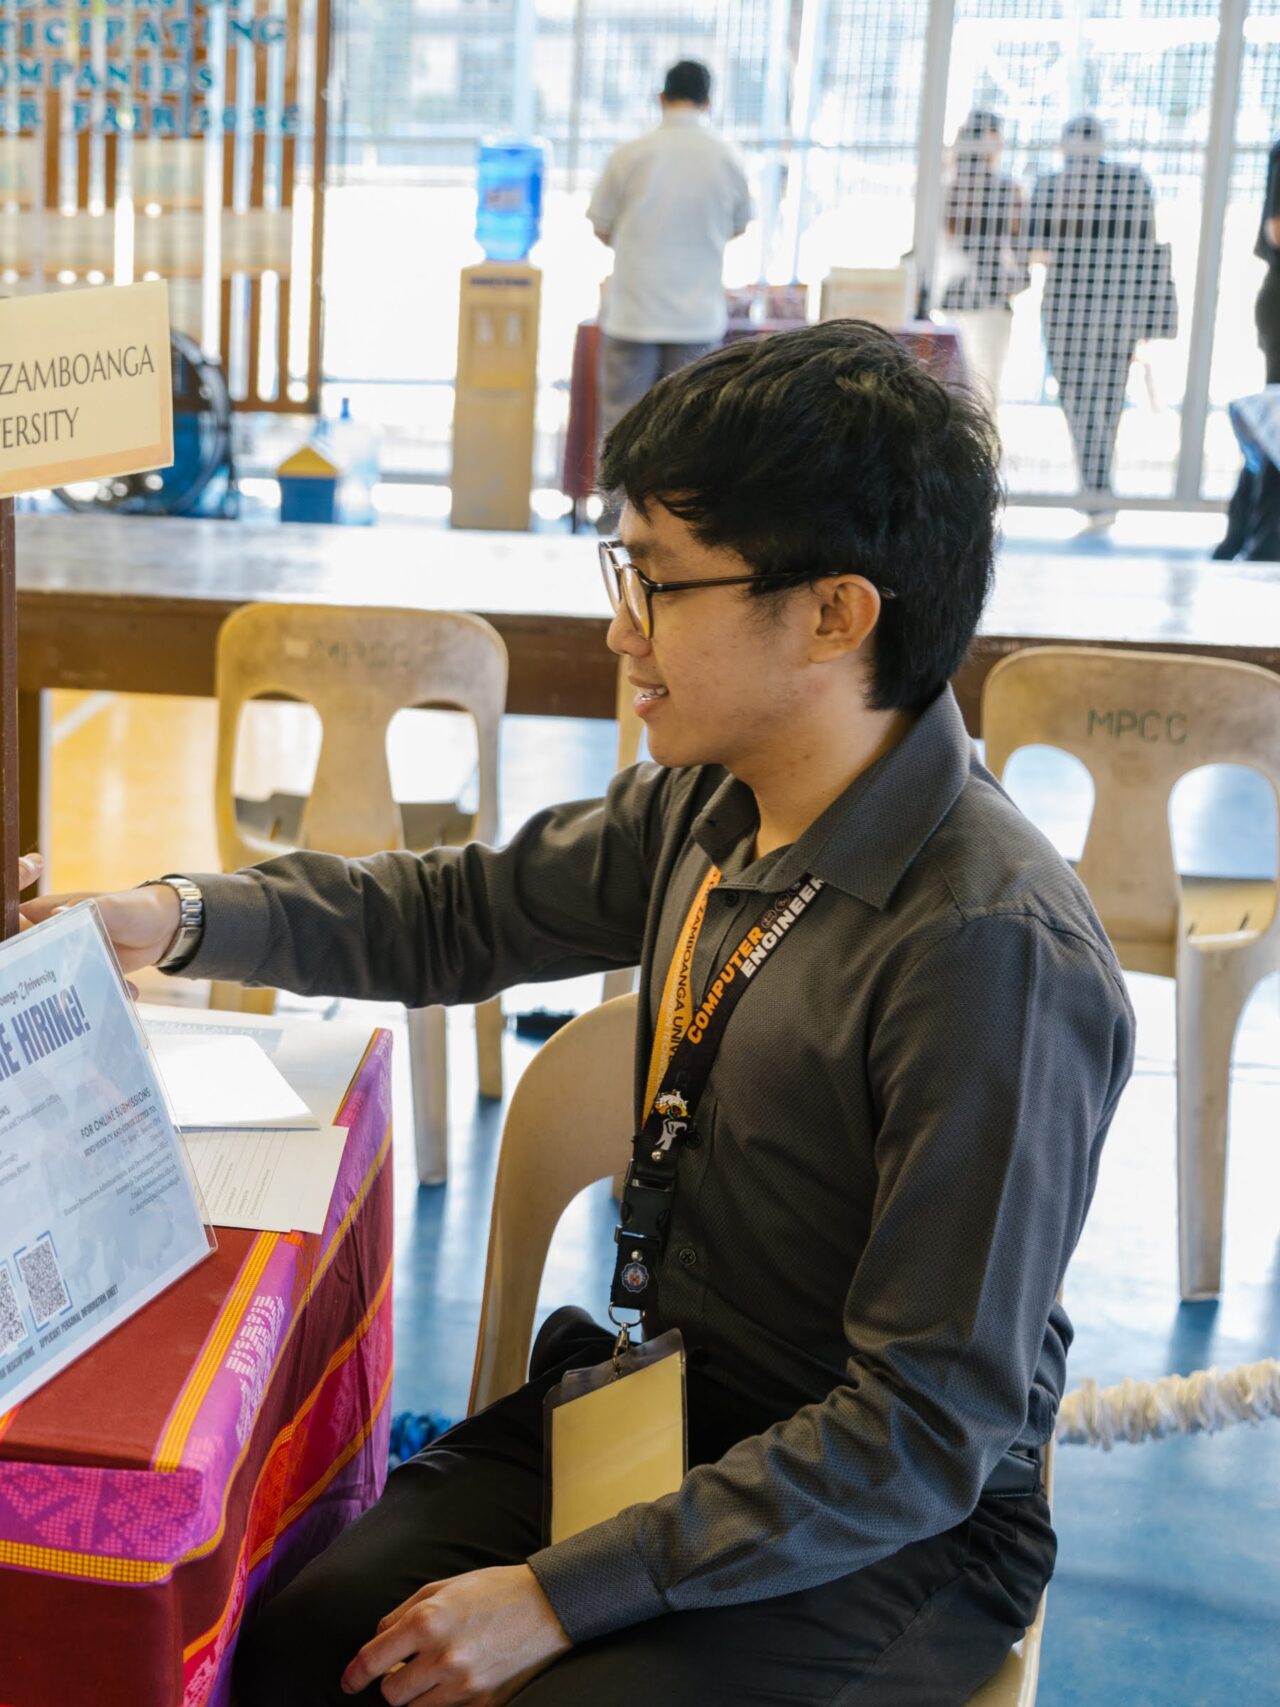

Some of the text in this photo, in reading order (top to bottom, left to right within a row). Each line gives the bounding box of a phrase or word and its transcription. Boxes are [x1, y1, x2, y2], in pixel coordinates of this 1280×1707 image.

[1088, 708, 1187, 746] MPCC
[687, 926, 765, 1044] COMPUTER
[11, 985, 91, 1064] HIRING!
[80, 1124, 94, 1138] FOR
[94, 1110, 116, 1131] ONLINE
